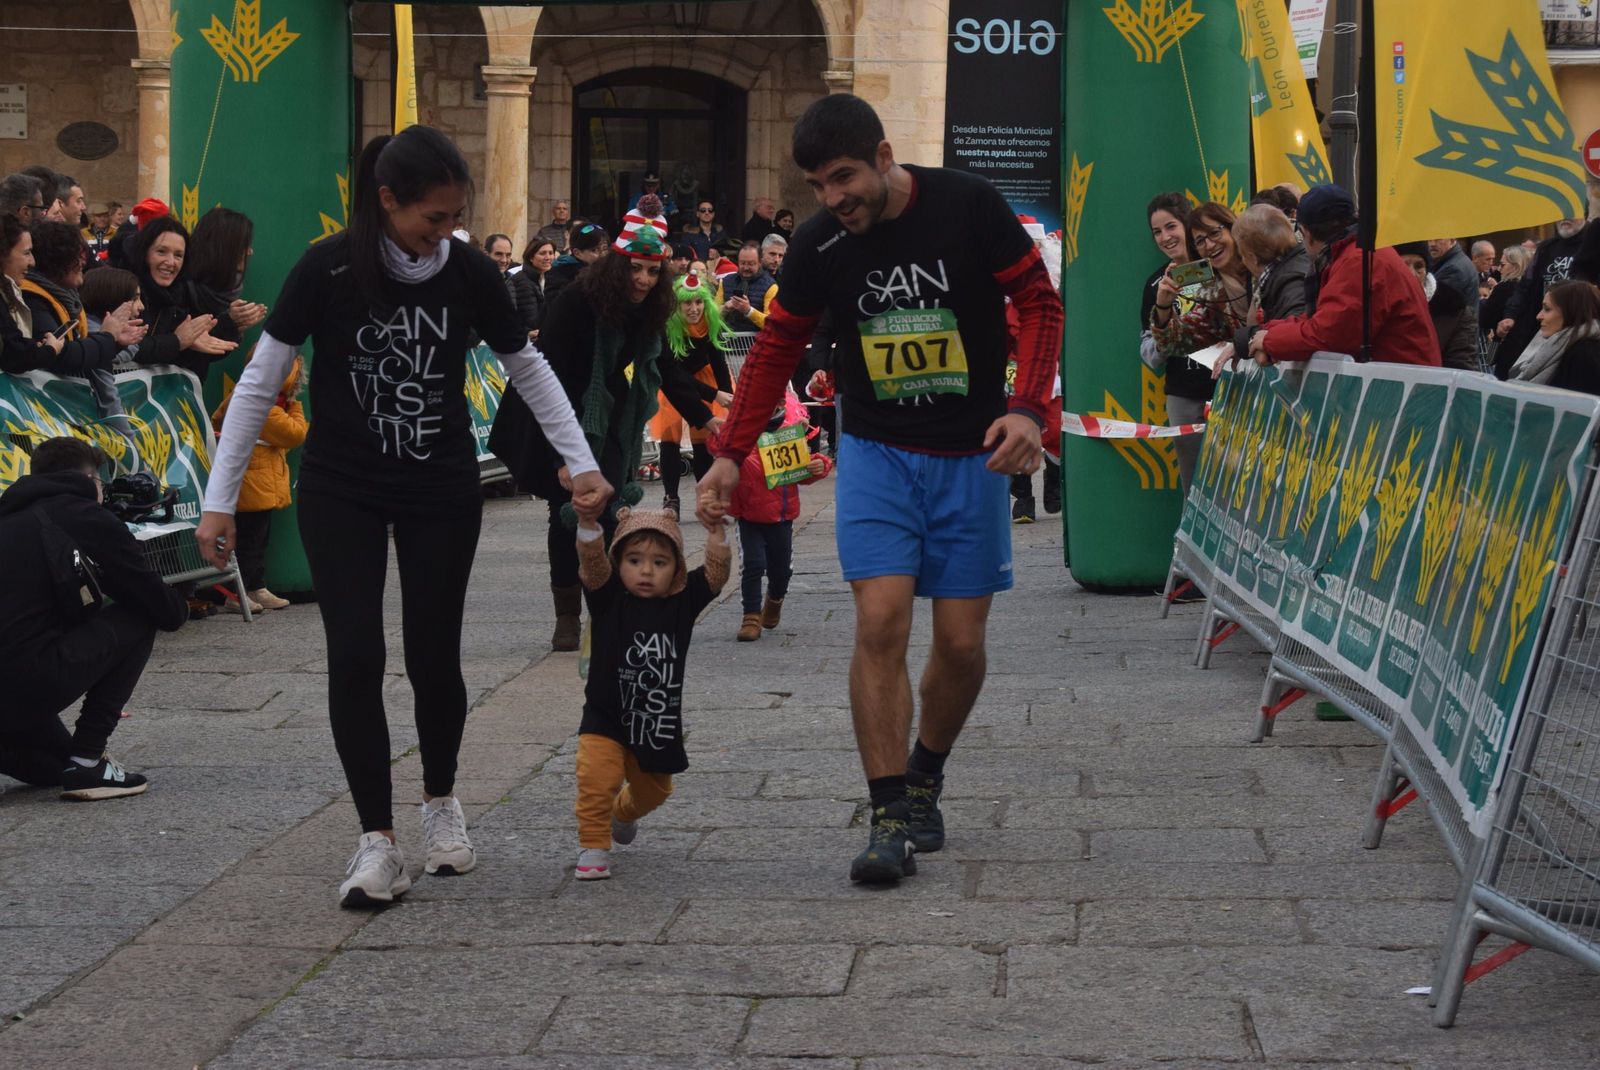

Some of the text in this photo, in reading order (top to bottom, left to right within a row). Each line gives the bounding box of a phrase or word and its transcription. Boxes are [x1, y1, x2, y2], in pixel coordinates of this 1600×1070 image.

[1272, 70, 1295, 111] León
[952, 125, 1053, 137] Desde la Policía Municipal
[953, 137, 1051, 147] de Zamora te ofrecemos
[956, 149, 1048, 158] nuestra ayuda cuando
[969, 160, 1034, 169] más la necesitas
[858, 259, 950, 317] SAN
[356, 305, 448, 353] SAN
[913, 322, 944, 332] RURAL
[352, 362, 374, 371] 2022
[379, 335, 446, 384] SIL
[873, 338, 949, 375] 707
[350, 371, 426, 420] VES
[932, 377, 967, 388] RURAL
[368, 415, 442, 460] TRE
[766, 442, 801, 471] 1331
[626, 631, 678, 668] SAN
[638, 656, 681, 691] SIL
[621, 711, 678, 750] TRE
